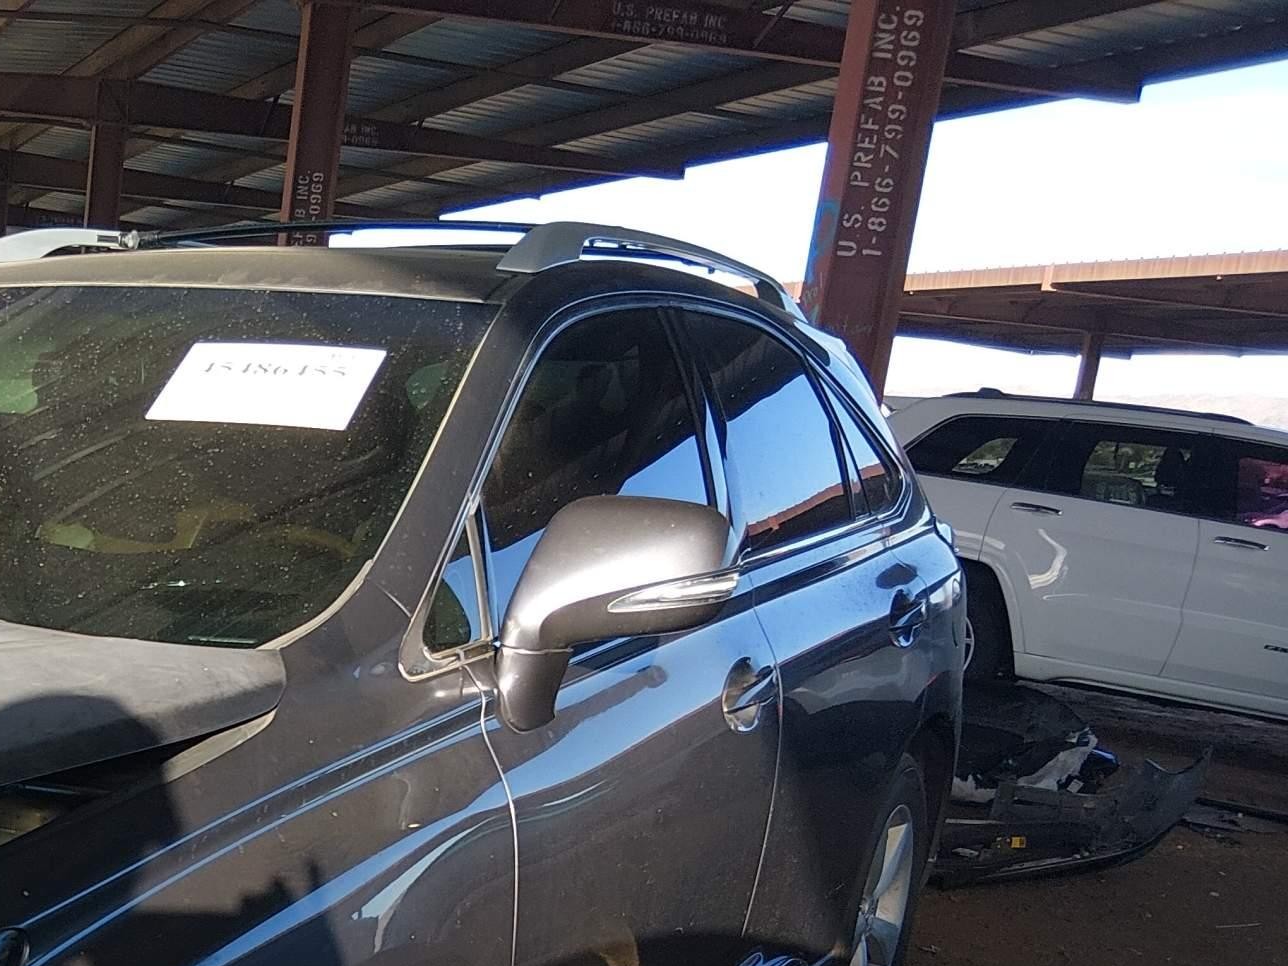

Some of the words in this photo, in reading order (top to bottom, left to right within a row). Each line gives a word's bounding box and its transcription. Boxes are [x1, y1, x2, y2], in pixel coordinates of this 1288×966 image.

[872, 6, 900, 59] INC.
[850, 75, 887, 188] PREFAB
[862, 9, 924, 257] 1-866-799-0969
[297, 170, 311, 200] INC.
[836, 206, 865, 257] U.S.
